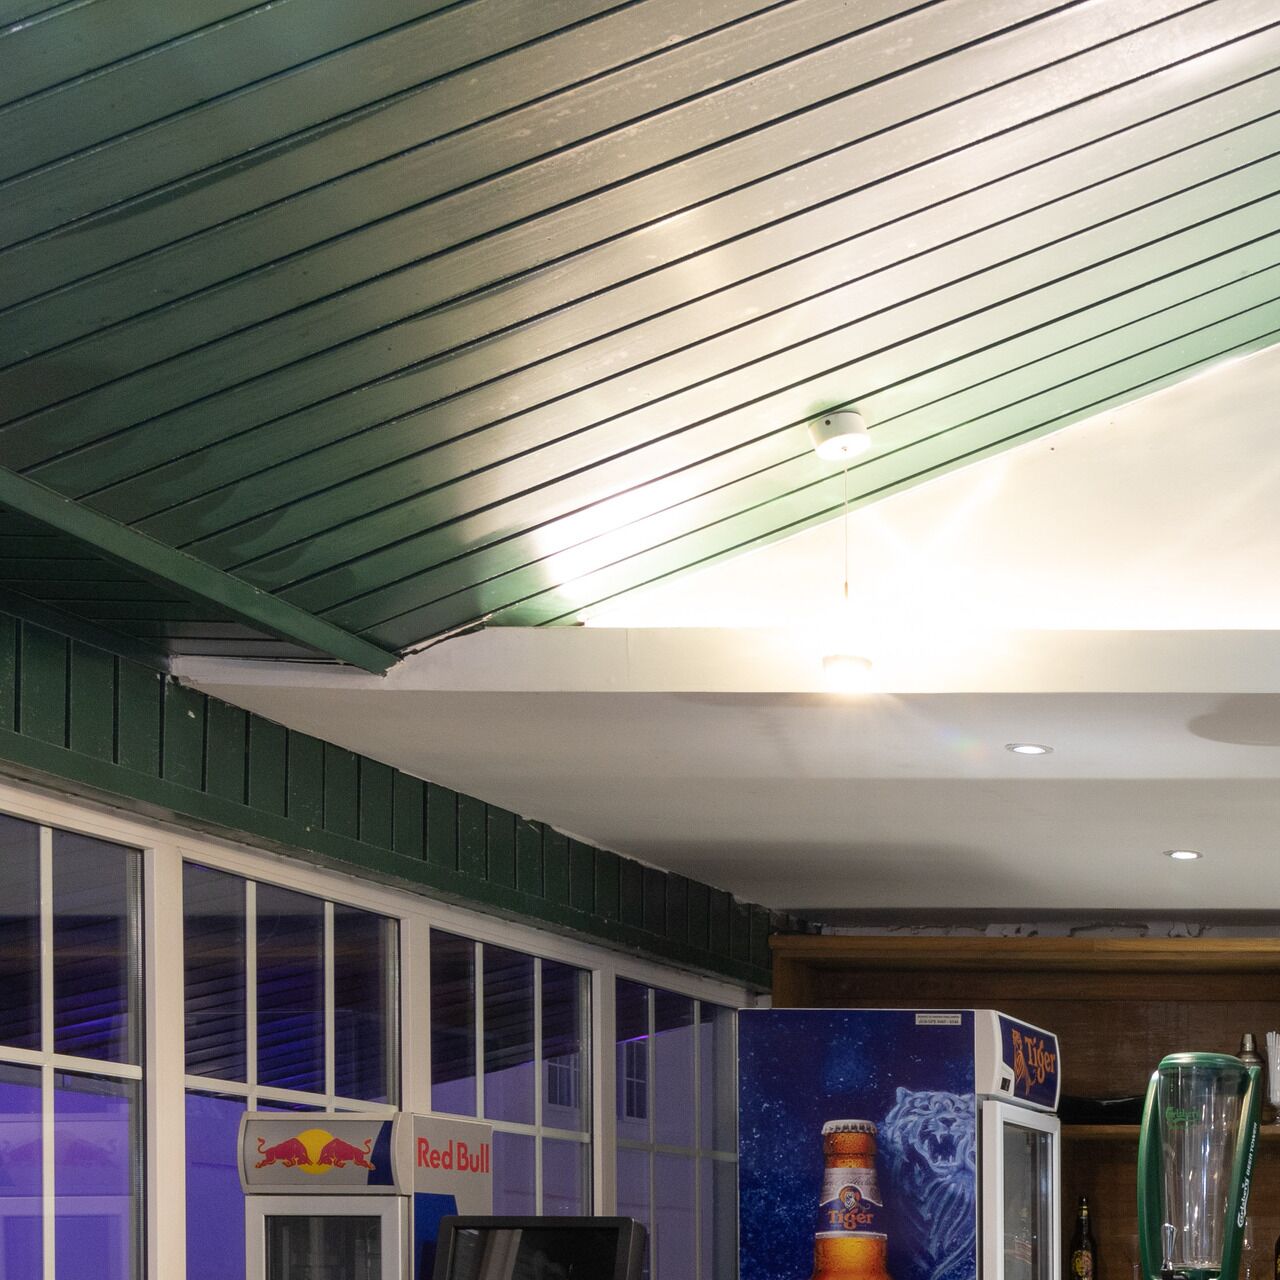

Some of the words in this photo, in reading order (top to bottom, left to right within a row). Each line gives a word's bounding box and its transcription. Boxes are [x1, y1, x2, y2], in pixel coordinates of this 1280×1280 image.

[1024, 1036, 1055, 1084] Tiger
[416, 1137, 453, 1170] Red
[457, 1142, 489, 1173] Bull
[827, 1208, 874, 1229] Tiger
[1237, 1177, 1249, 1228] Carlsberg
